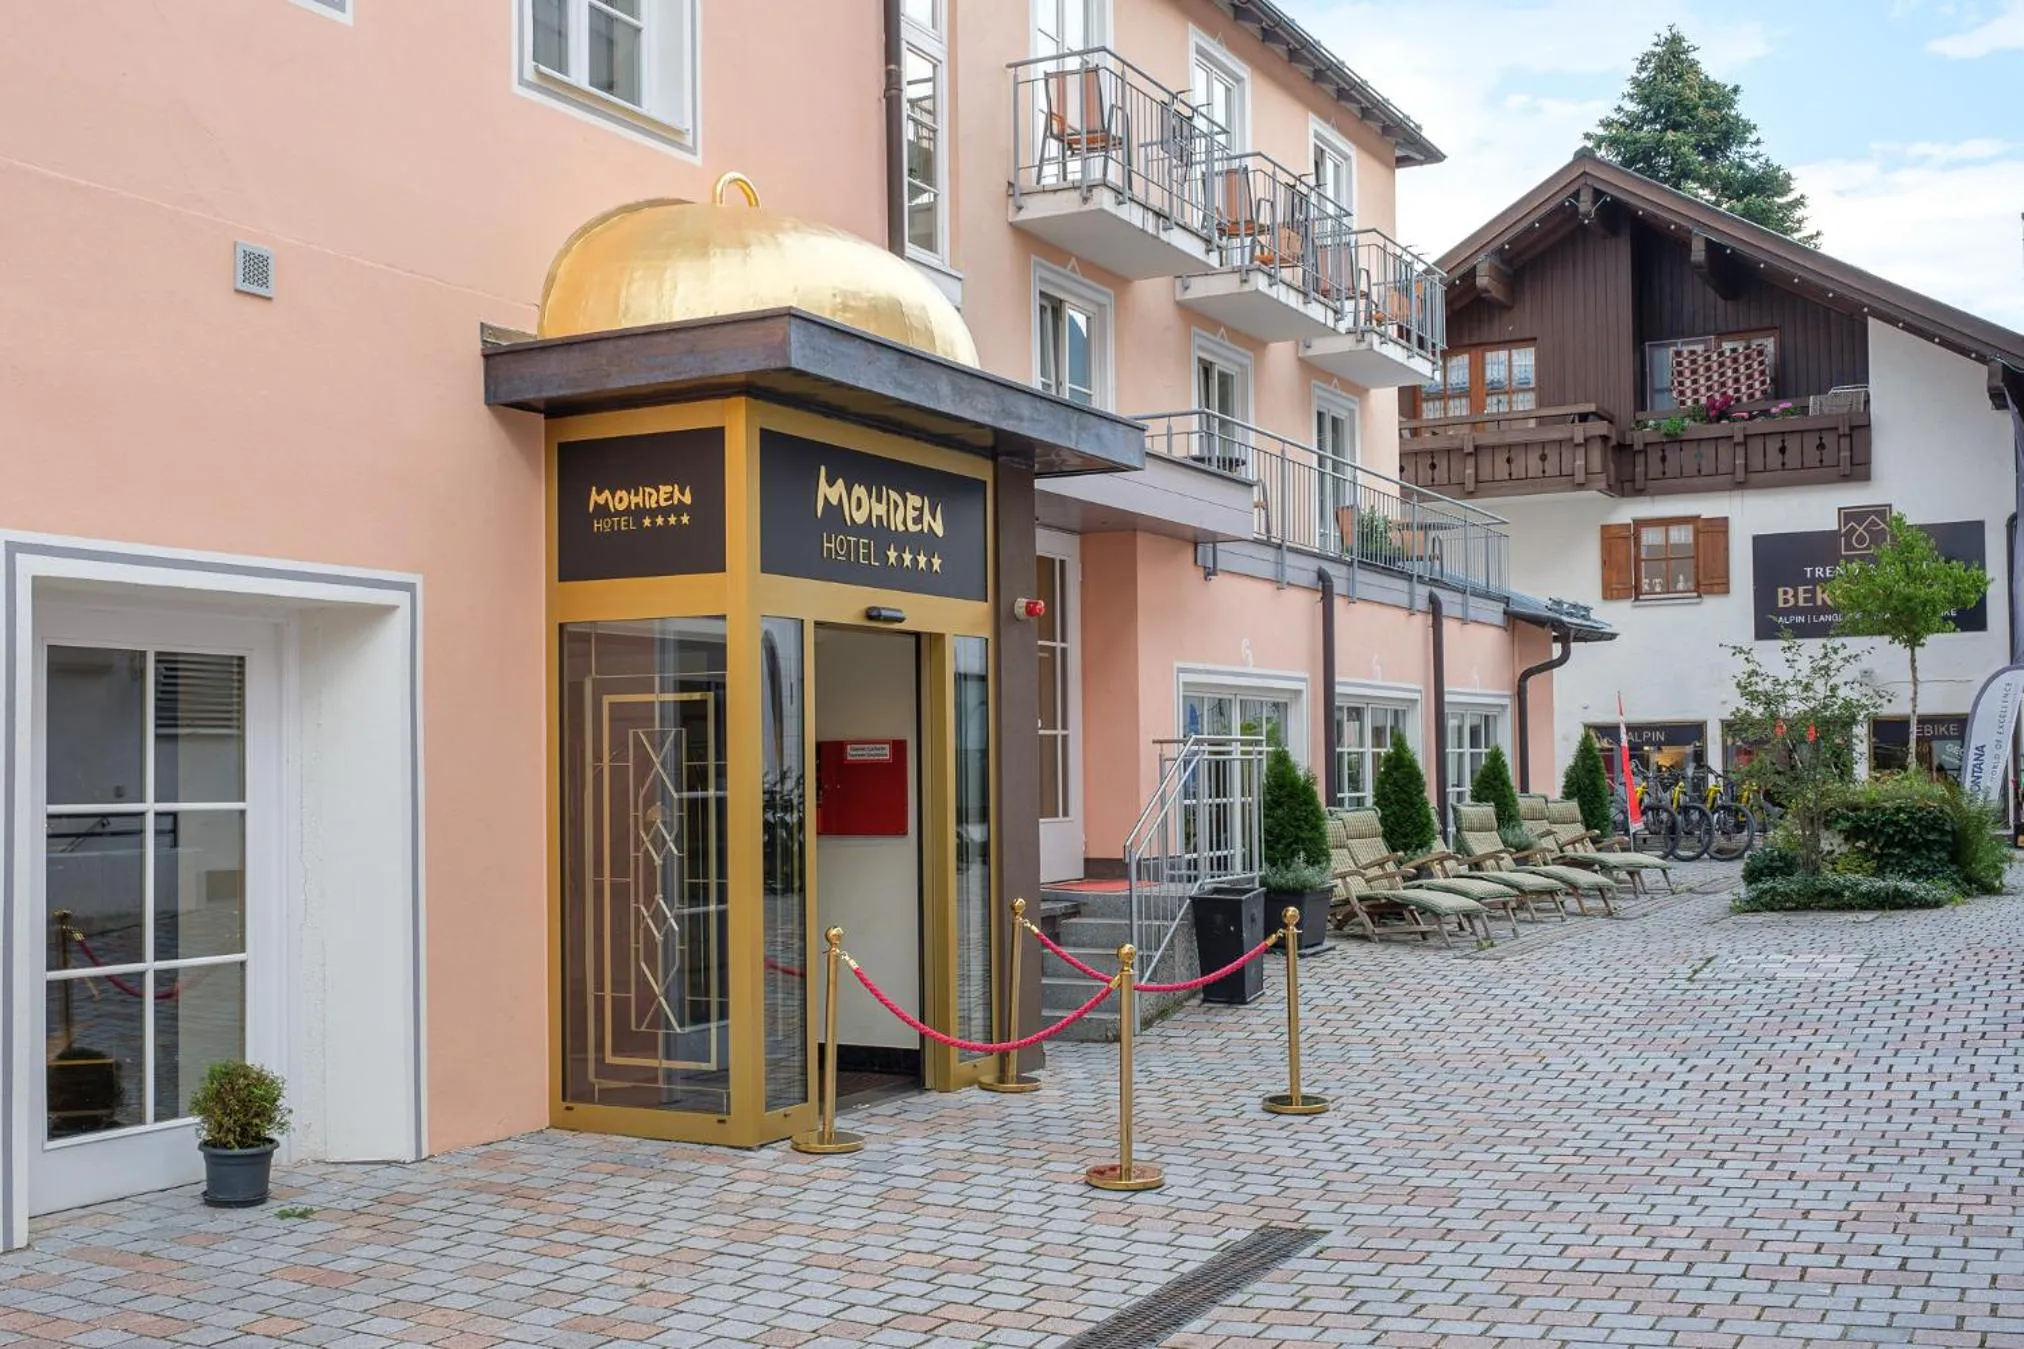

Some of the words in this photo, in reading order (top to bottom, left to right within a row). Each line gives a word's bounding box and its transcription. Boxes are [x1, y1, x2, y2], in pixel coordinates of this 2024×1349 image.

[588, 483, 692, 514] MOHREN
[816, 464, 944, 538] MOHREN
[594, 515, 637, 533] HOTEL
[823, 531, 880, 567] HOTEL
[1804, 565, 1859, 579] TREN
[1778, 614, 1805, 624] ALPIN
[1627, 730, 1666, 743] ALPIN
